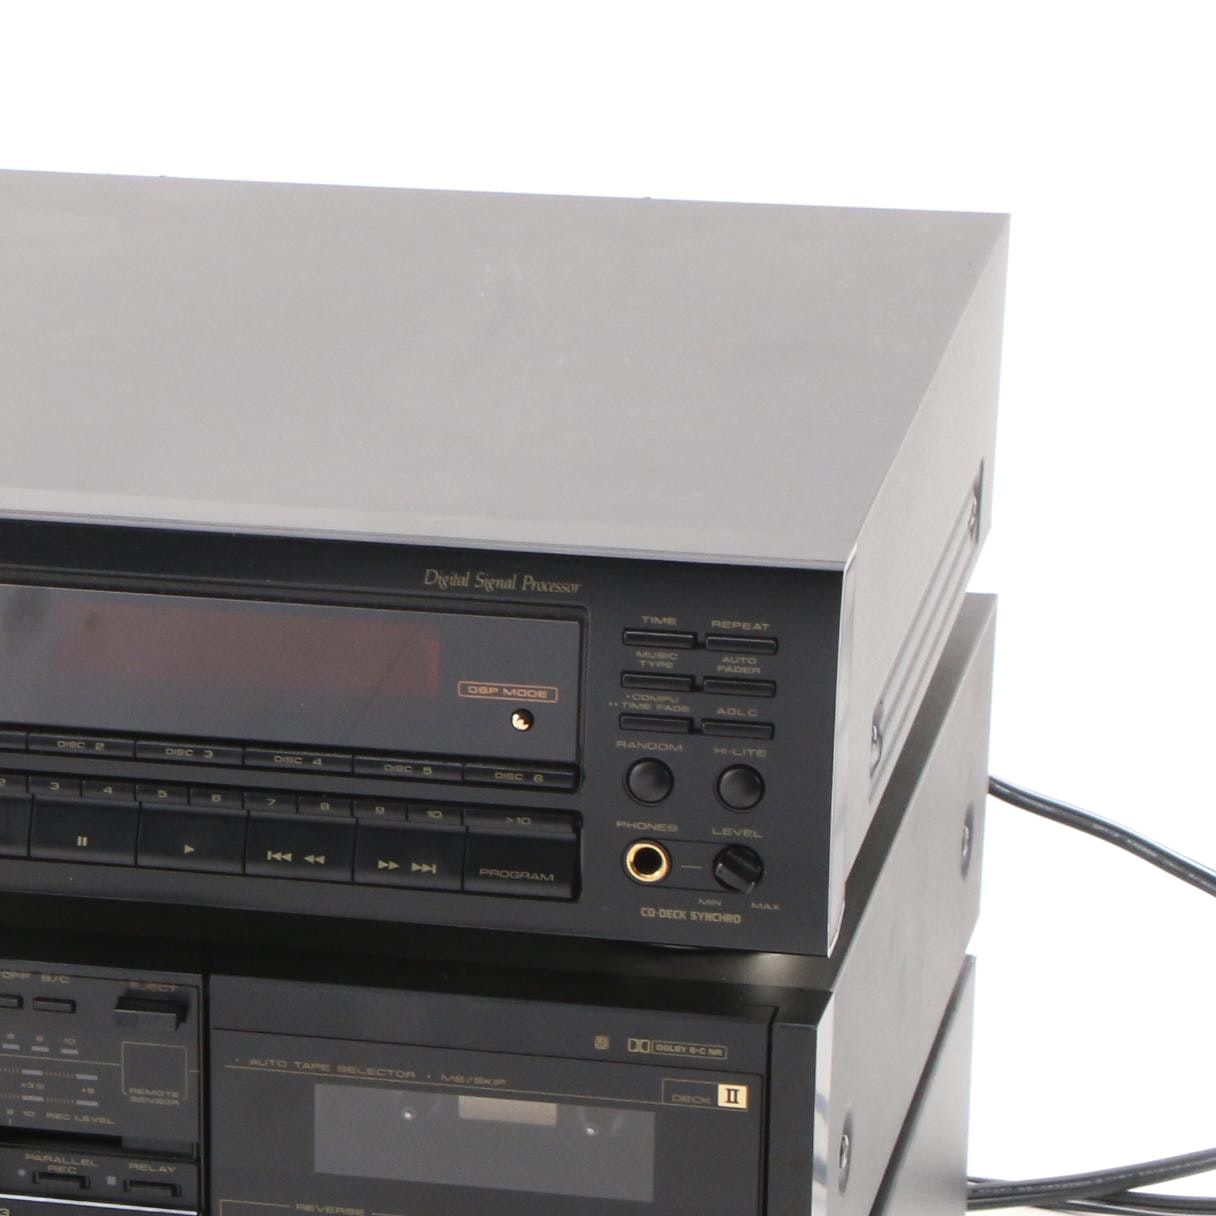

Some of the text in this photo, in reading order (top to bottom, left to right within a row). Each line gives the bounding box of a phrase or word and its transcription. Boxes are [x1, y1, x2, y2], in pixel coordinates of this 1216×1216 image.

[424, 569, 584, 595] Digital Signal Processor
[640, 615, 678, 626] TIME
[711, 619, 771, 631] REPEAT
[636, 651, 678, 660] MUSIC
[722, 656, 757, 665] AUTO
[639, 659, 674, 669] TYPE
[717, 664, 761, 674] FADER
[468, 685, 548, 699] DSP MODE
[57, 741, 105, 751] DISC 2
[615, 740, 683, 752] RANDOM
[165, 748, 214, 759] DISC 3
[713, 747, 768, 758] HI-LITE
[273, 755, 323, 766] DISC 4
[384, 764, 432, 776] DISC 5
[494, 771, 544, 784] DISC 6
[616, 820, 679, 832] PHONES
[712, 827, 764, 839] LEVEL
[479, 867, 555, 882] PROGRAM
[751, 902, 780, 911] MAX
[640, 907, 742, 924] CD-DECK SYNCHRO
[250, 1058, 287, 1068] AUTO
[293, 1061, 330, 1072] TAPE
[337, 1065, 416, 1078] SELECTOR
[672, 1094, 712, 1105] DECK
[24, 1153, 100, 1168] PARALLEL
[47, 1164, 77, 1174] REC
[128, 1162, 177, 1174] RELAY
[296, 1202, 366, 1216] REVERSE
